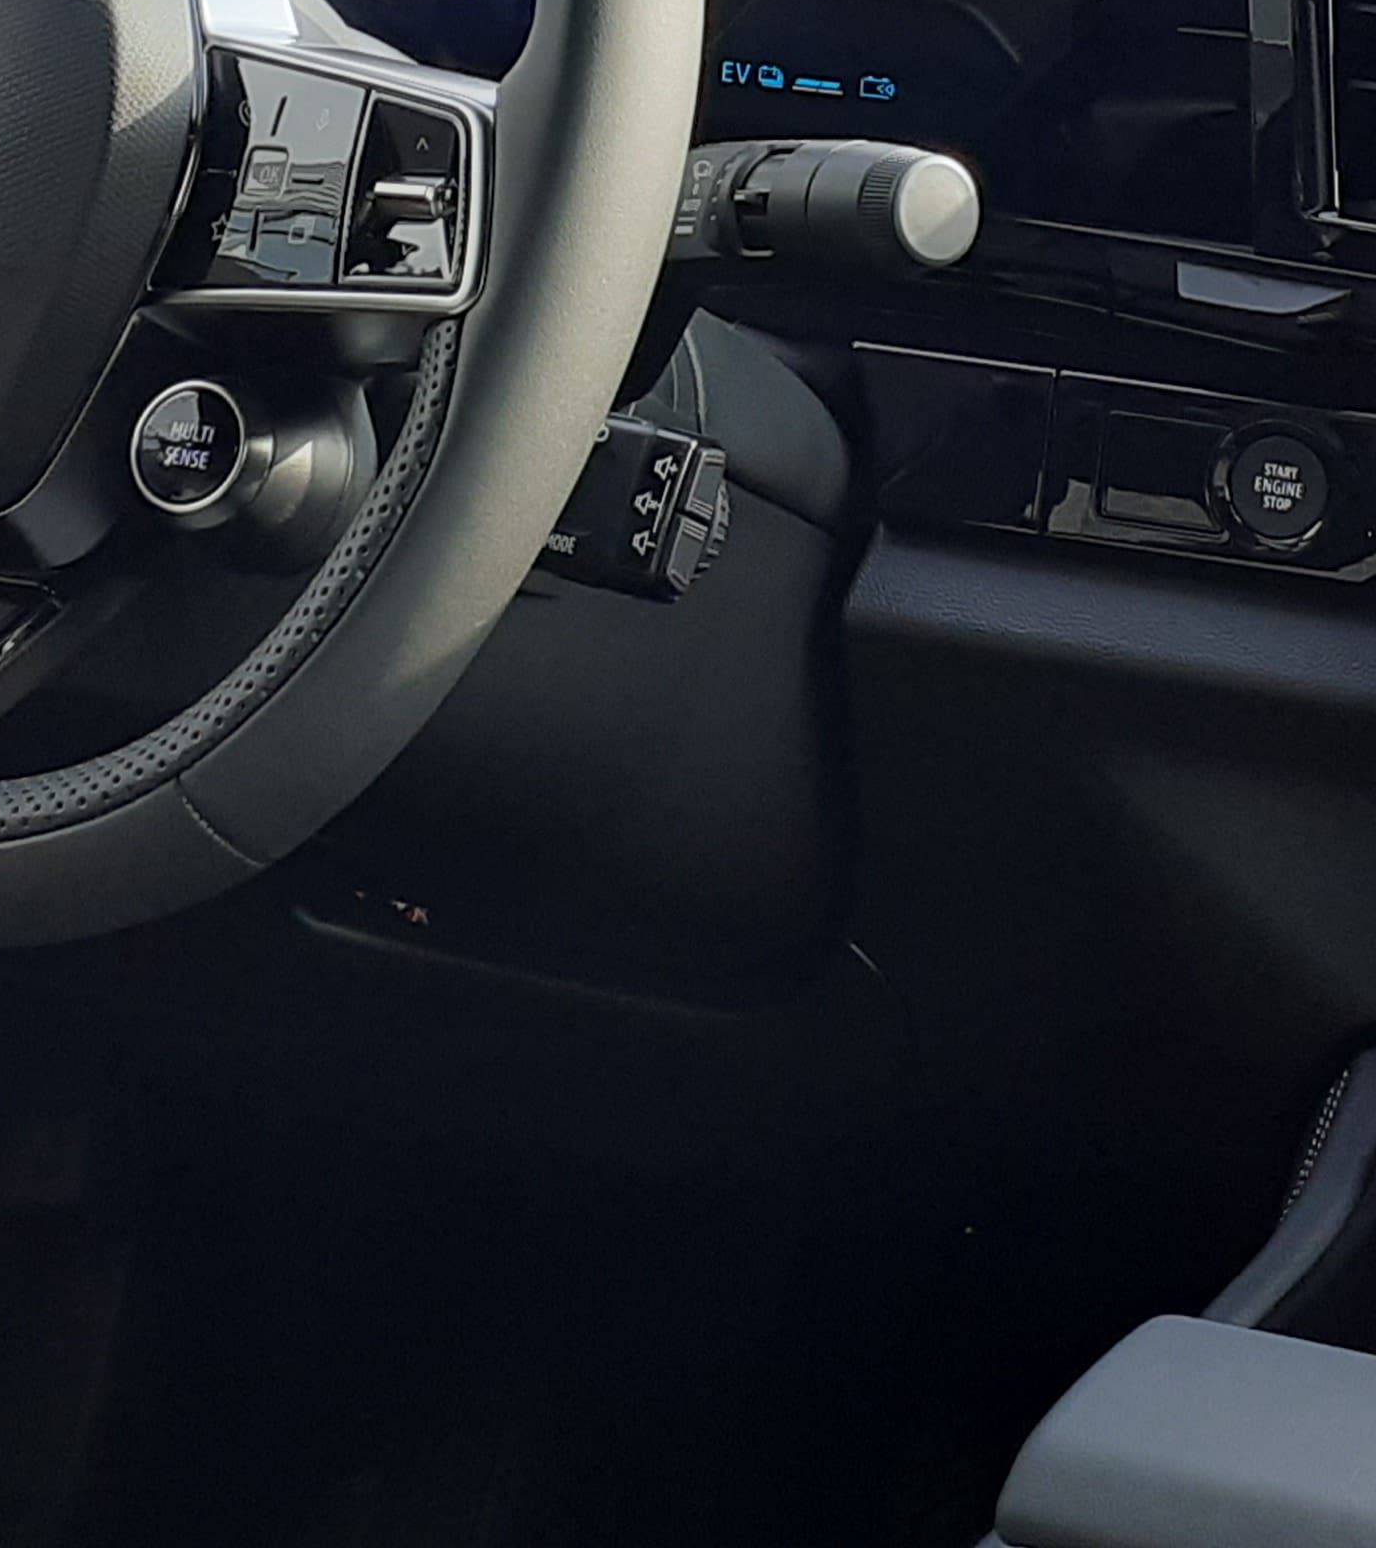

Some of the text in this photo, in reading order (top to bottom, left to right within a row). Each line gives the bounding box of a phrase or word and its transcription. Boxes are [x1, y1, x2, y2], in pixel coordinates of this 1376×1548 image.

[721, 61, 750, 84] EV
[171, 420, 217, 444] MULTI
[163, 445, 211, 471] SENSE
[1263, 462, 1300, 480] START
[1253, 476, 1305, 499] ENGINE
[1262, 494, 1292, 511] STOP
